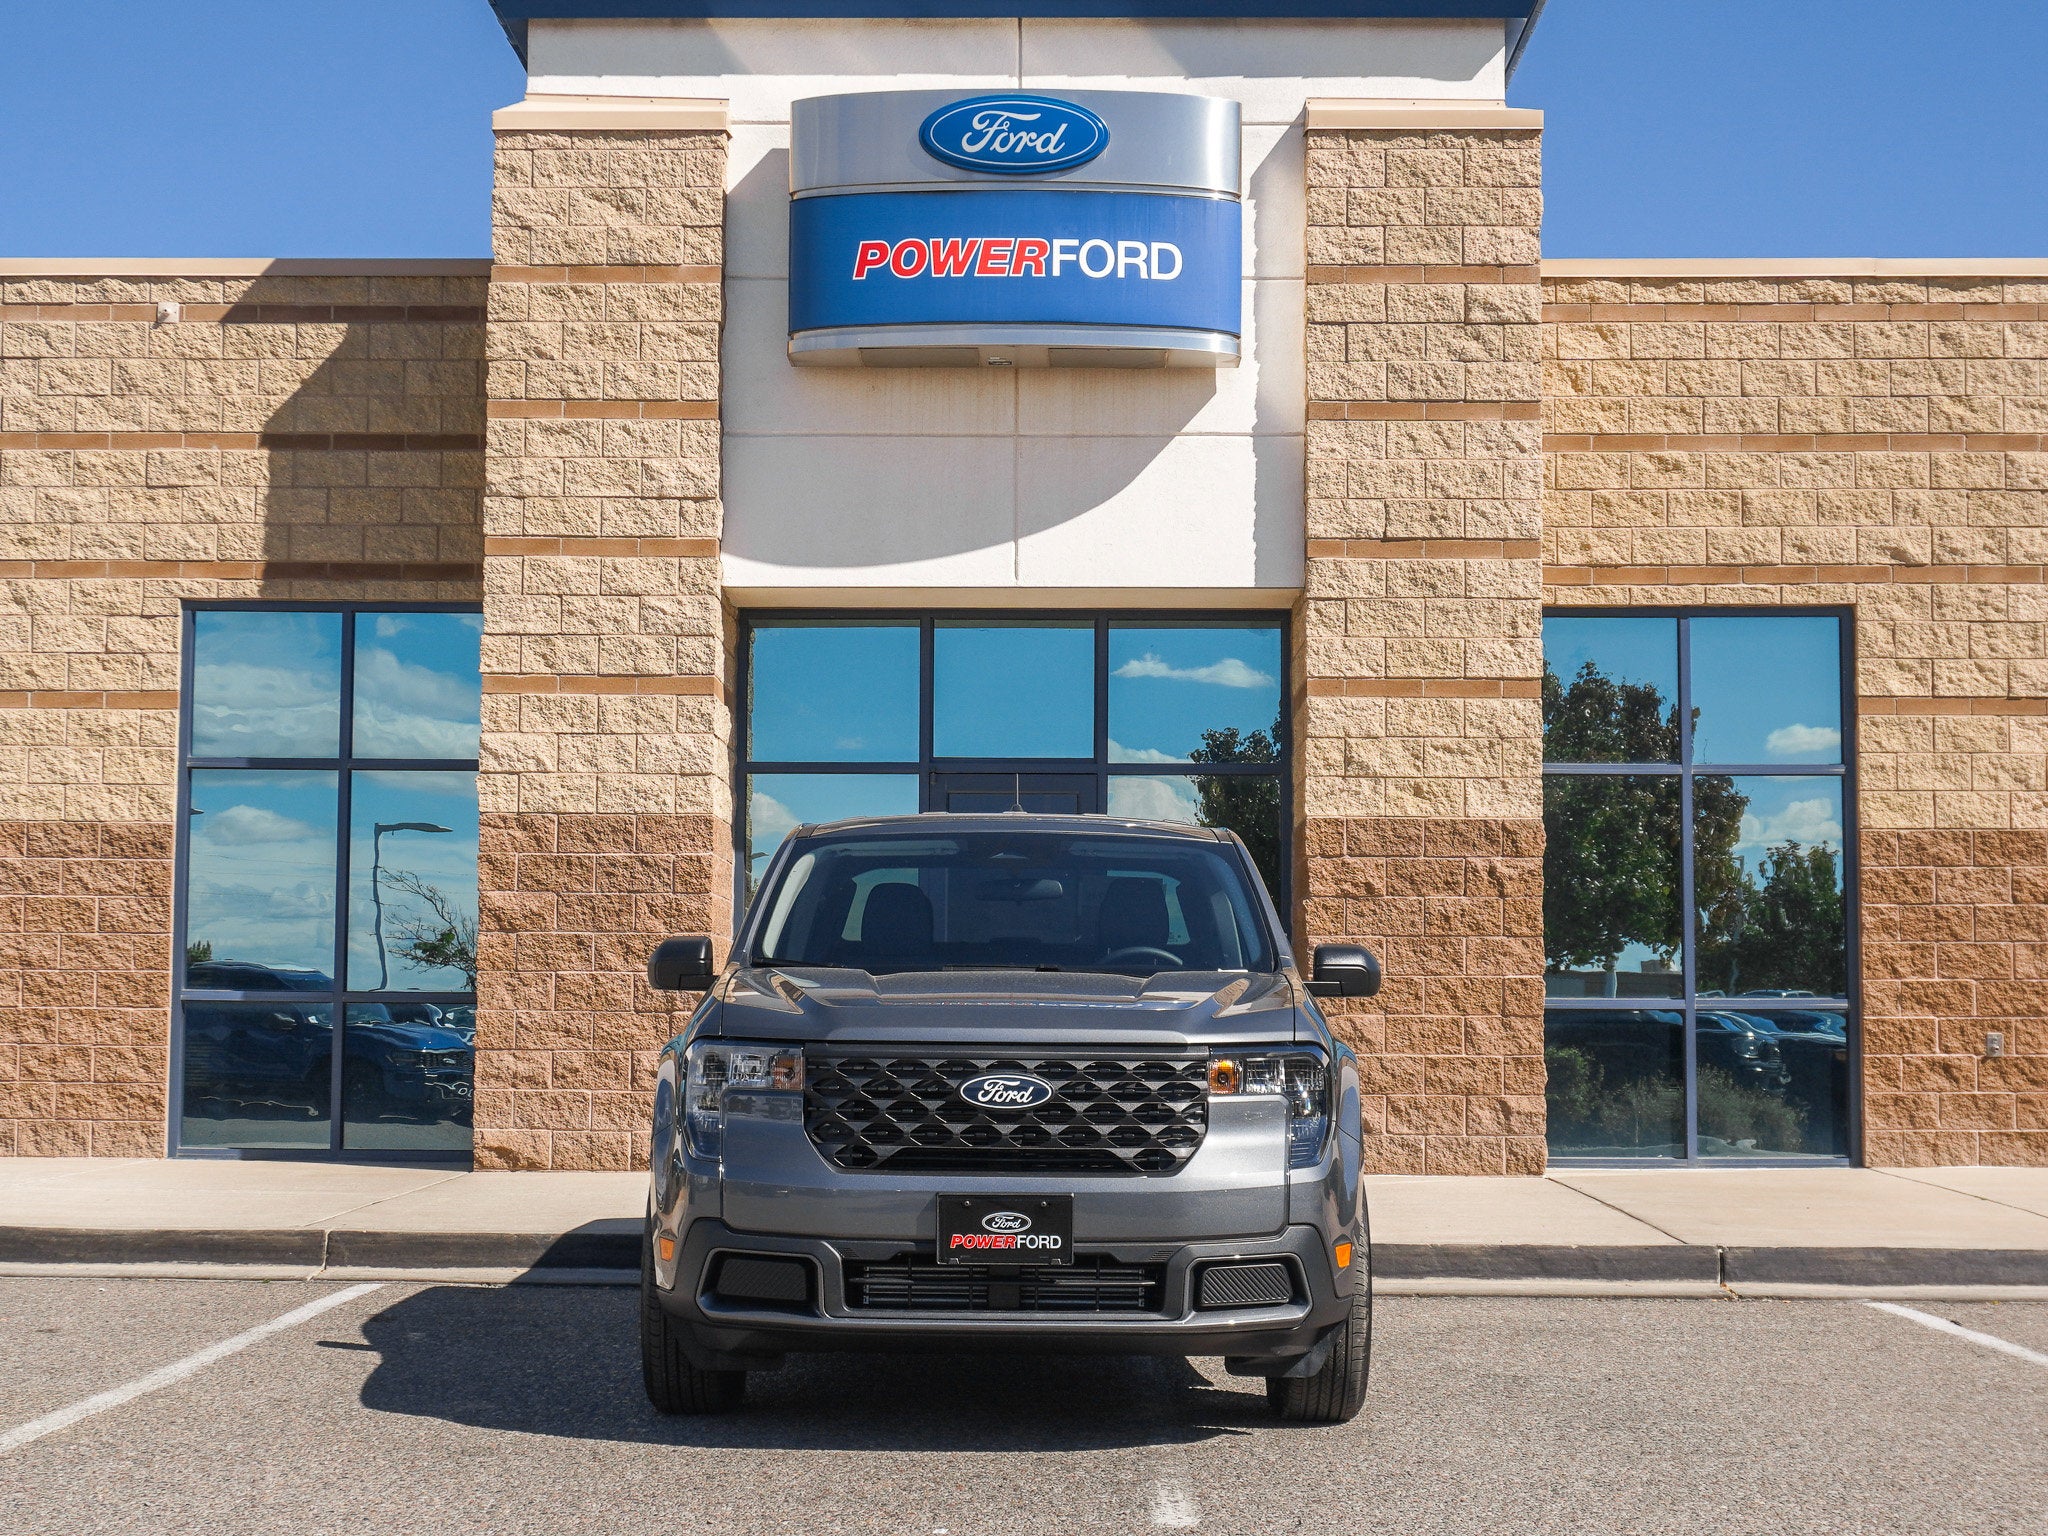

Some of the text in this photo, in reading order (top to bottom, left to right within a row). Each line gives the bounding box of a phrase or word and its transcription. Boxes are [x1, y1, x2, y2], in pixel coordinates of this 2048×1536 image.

[961, 110, 1068, 155] Ford
[853, 238, 1184, 281] POWERFORD
[977, 1079, 1035, 1103] Ford
[991, 1215, 1022, 1230] Ford
[950, 1234, 1062, 1249] POWERFORD
